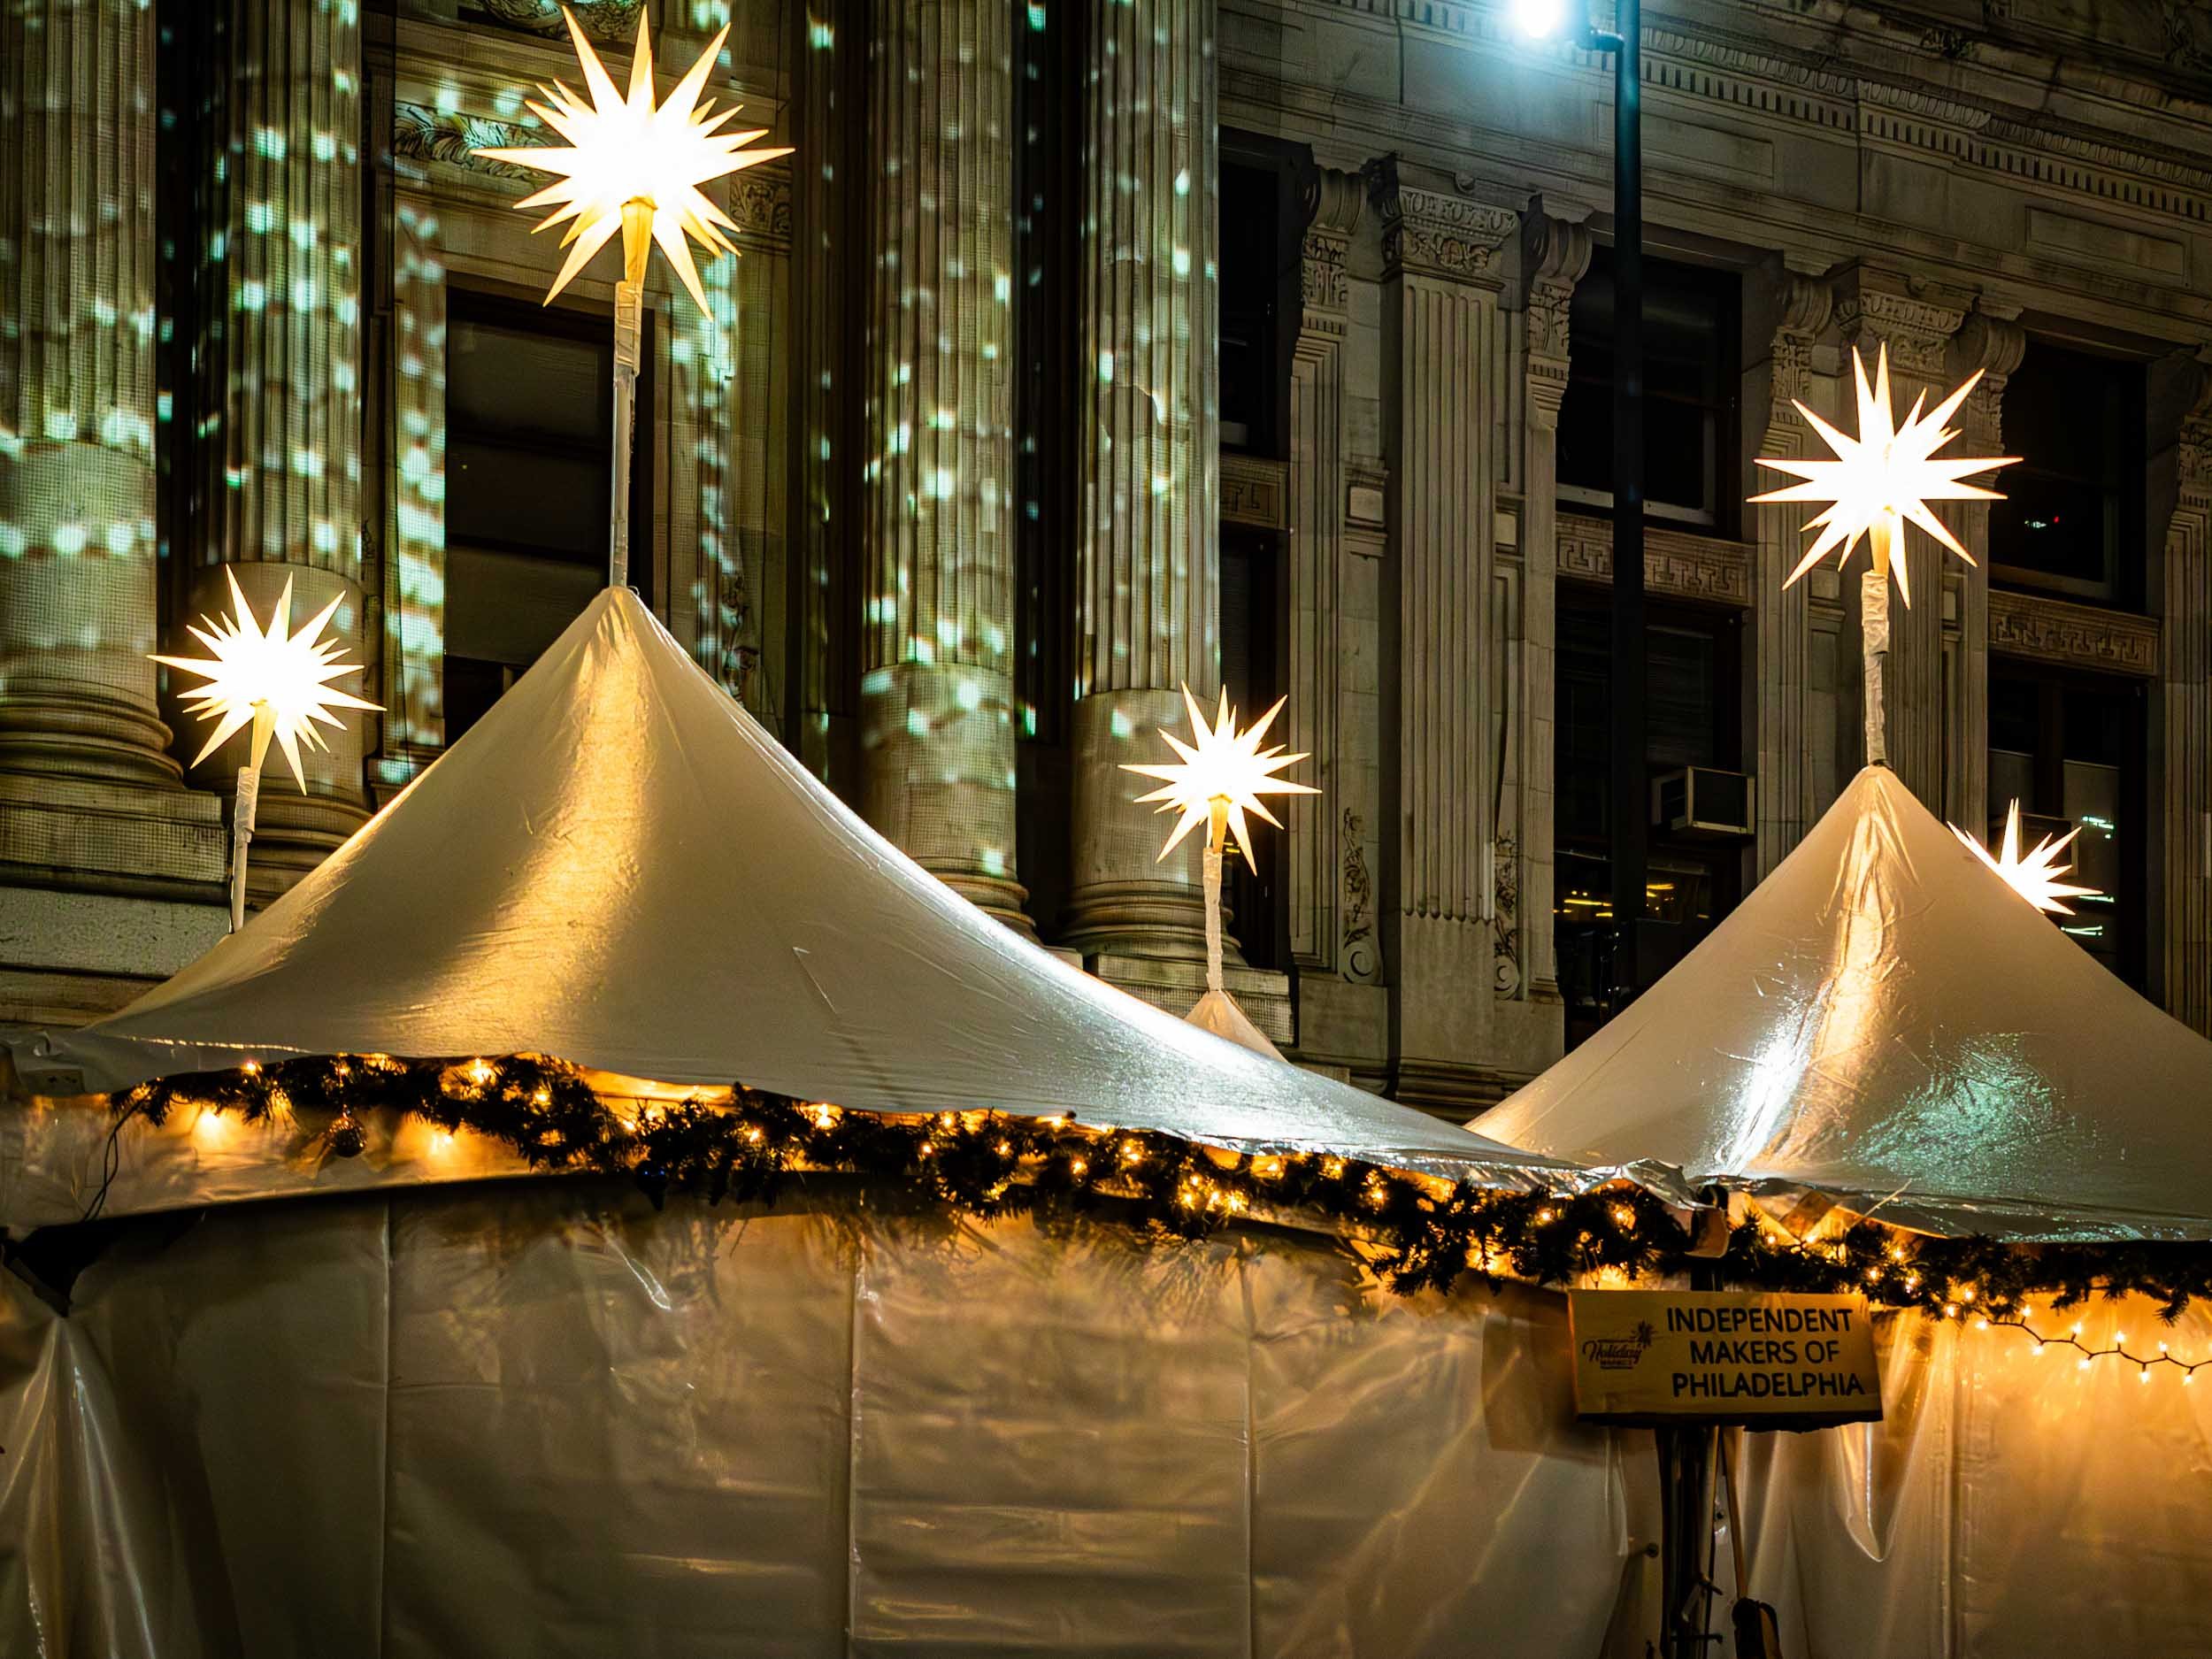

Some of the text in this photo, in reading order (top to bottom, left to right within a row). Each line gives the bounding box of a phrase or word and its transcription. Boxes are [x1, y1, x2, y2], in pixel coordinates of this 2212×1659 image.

[1666, 1308, 1854, 1333] INDEPENDENT
[1690, 1340, 1840, 1364] MAKERS OF
[1671, 1372, 1865, 1398] PHILADELPHIA
